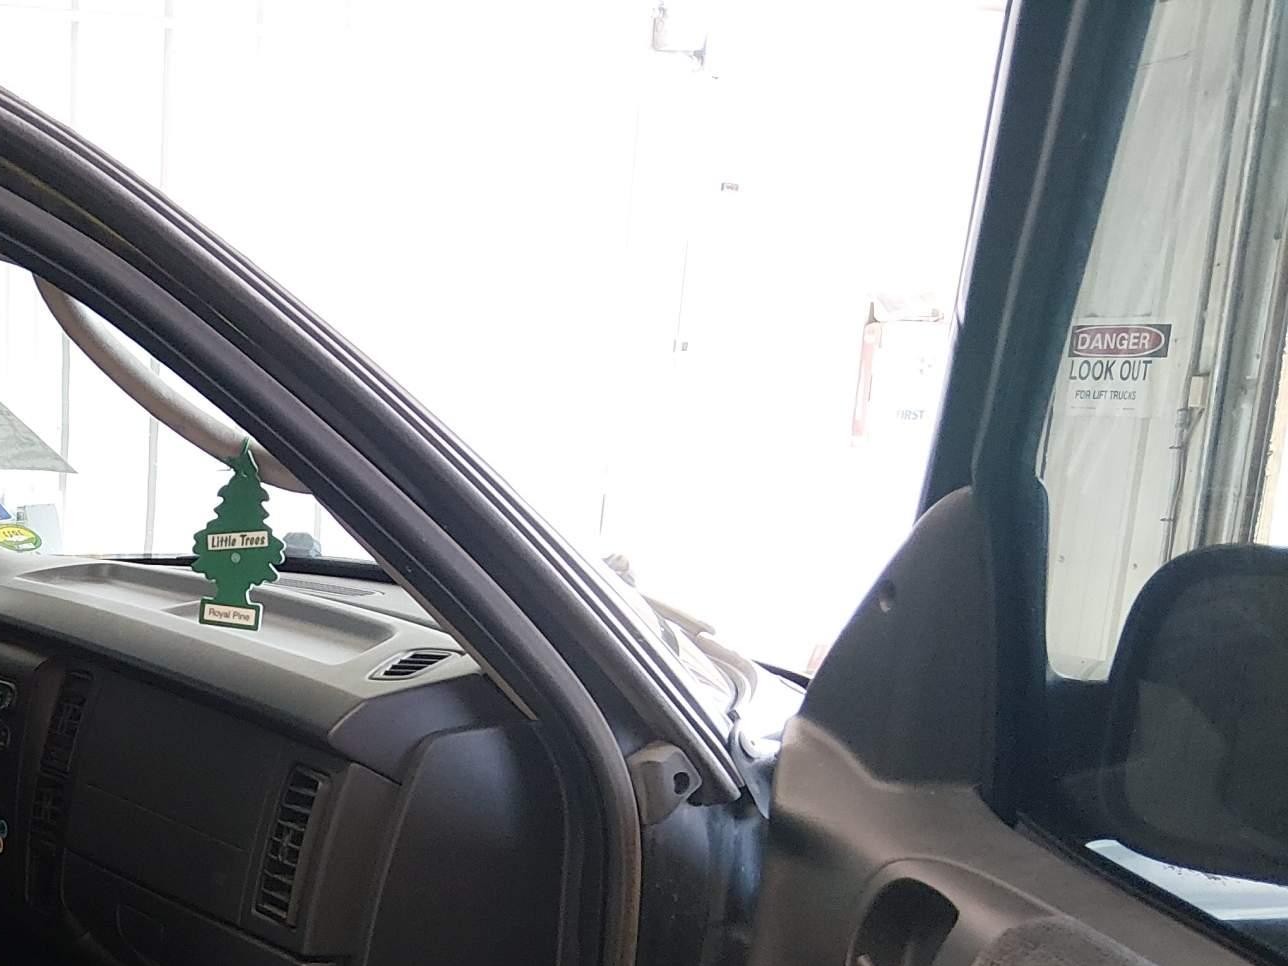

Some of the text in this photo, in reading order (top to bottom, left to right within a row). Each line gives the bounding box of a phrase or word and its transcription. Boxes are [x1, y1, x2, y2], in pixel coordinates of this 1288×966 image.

[1077, 333, 1150, 350] DANGER
[1070, 360, 1152, 380] LOOK OUT
[1075, 391, 1136, 400] FOR LIFT TRUCKS
[211, 535, 266, 548] Little Trees
[209, 608, 250, 621] Royal Pine
